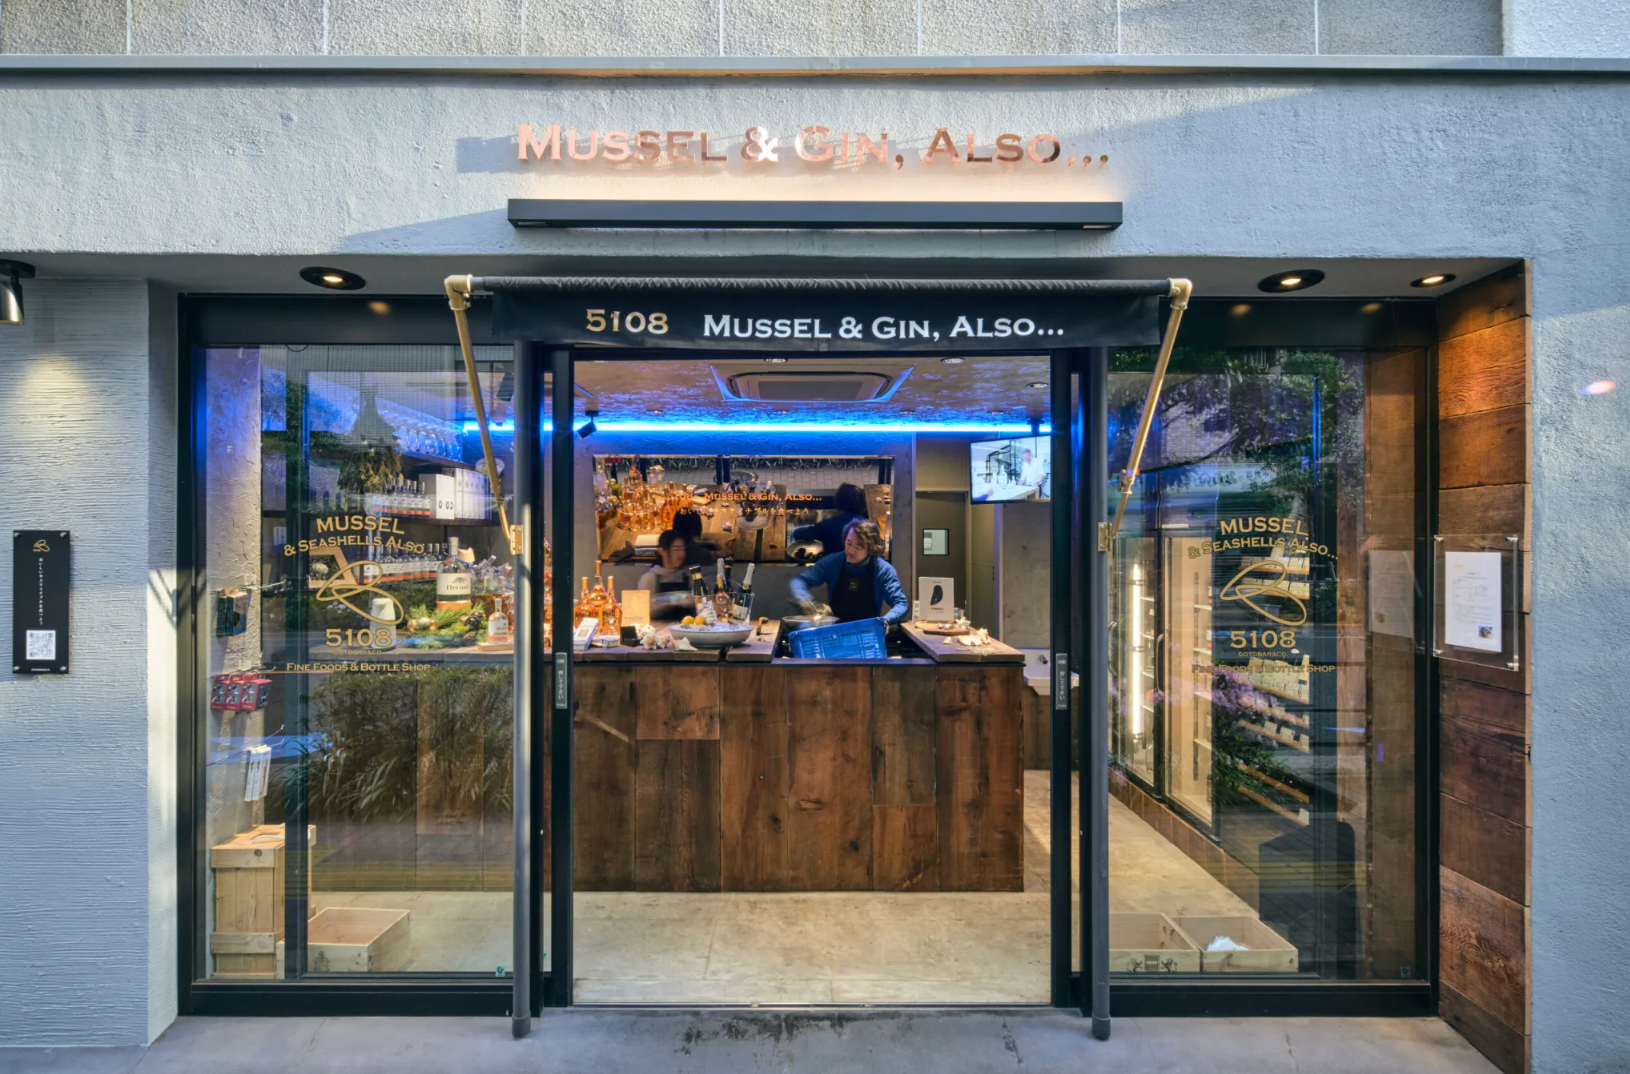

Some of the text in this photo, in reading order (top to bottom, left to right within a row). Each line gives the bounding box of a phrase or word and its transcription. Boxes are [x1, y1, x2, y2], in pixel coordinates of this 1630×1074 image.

[517, 123, 728, 163] MUSSEL
[740, 126, 778, 162] &
[795, 126, 904, 170] GIN,
[586, 308, 669, 335] 5108
[703, 314, 1064, 342] MUSSEL & GIN, ALSO...
[704, 492, 747, 501] MUSSEL
[748, 493, 757, 501] &
[316, 515, 405, 535] MUSSEL
[1220, 517, 1309, 536] MUSSEL
[284, 544, 297, 557] &
[298, 535, 383, 553] SEASHELLS
[1187, 537, 1339, 561] & SEASHELLS ALSO...
[325, 628, 393, 648] 5108
[1229, 630, 1297, 649] 5108
[286, 662, 431, 672] FINE FOODS & BOTTLE SHOP
[1306, 664, 1336, 673] SHOP
